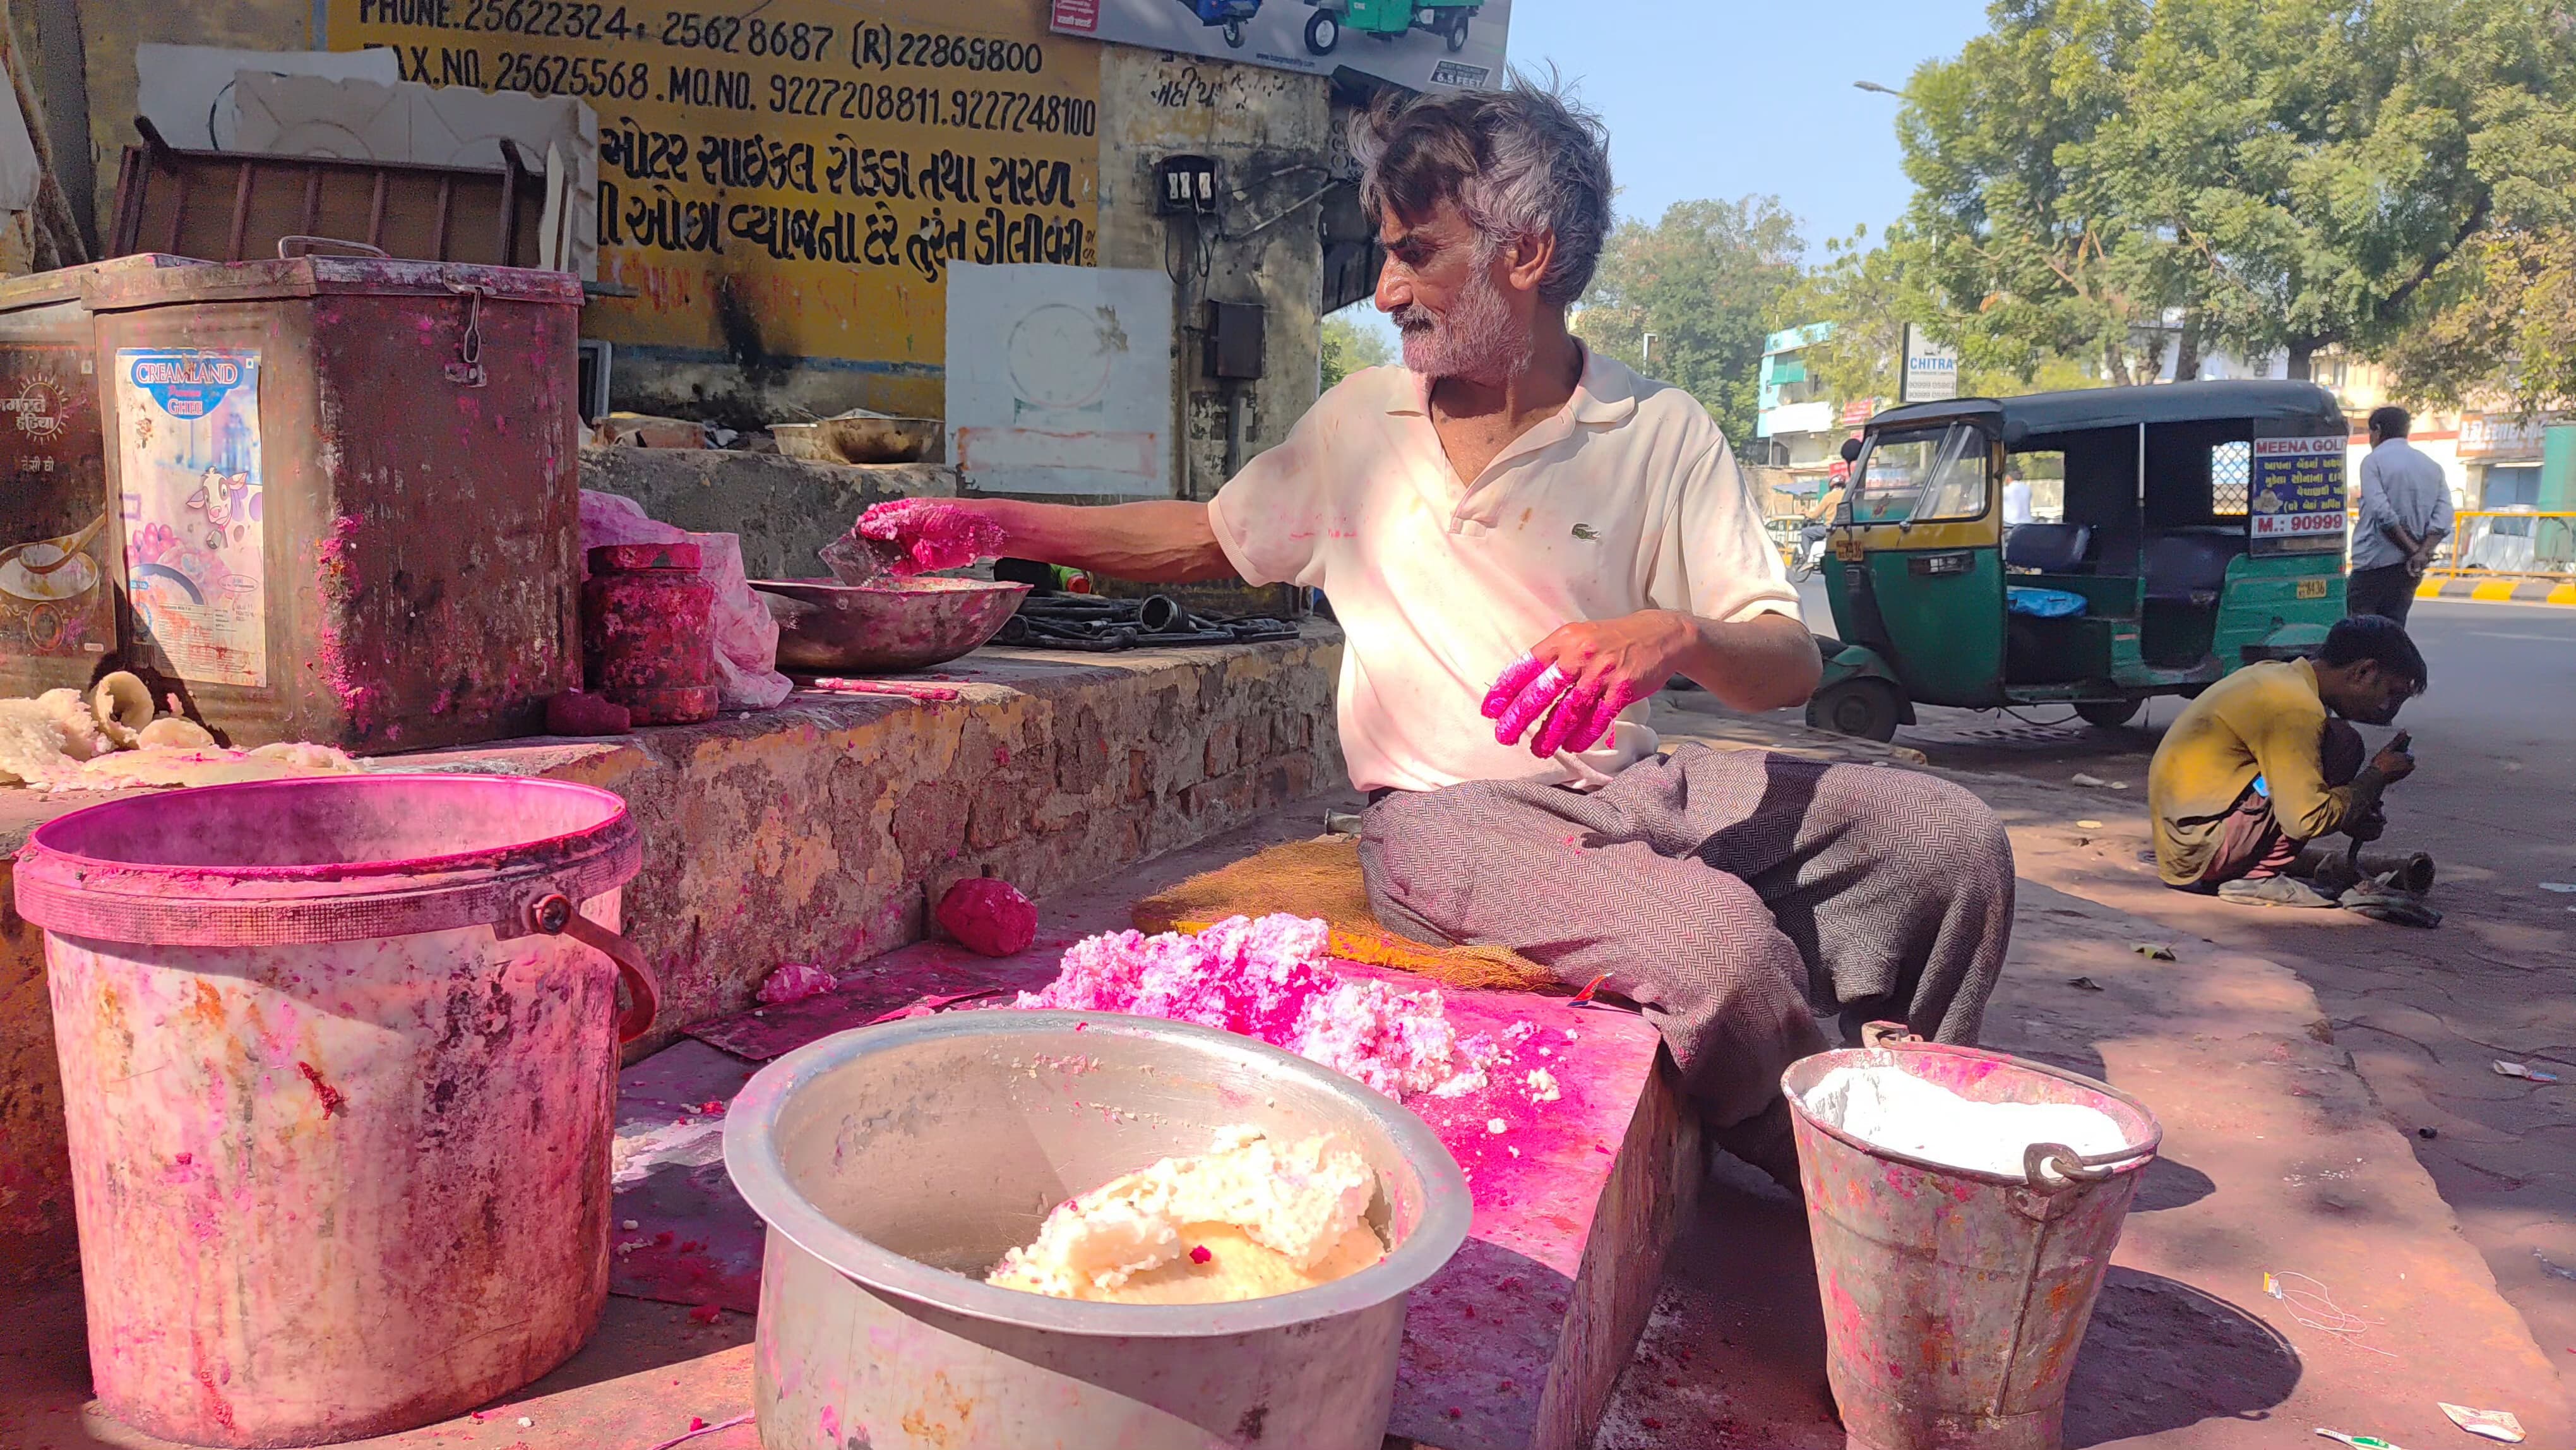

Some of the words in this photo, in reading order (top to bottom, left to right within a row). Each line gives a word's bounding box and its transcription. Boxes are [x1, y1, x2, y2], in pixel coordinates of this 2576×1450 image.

[1437, 73, 1454, 83] 6.5
[1457, 76, 1482, 87] FEET
[919, 149, 981, 204] તથા
[984, 157, 1076, 208] સરળ
[1910, 357, 1953, 370] CHITRA
[136, 362, 239, 385] CREAMLAND
[167, 398, 203, 416] GHEE
[2256, 440, 2309, 454] MEENA
[2291, 514, 2344, 532] 90999
